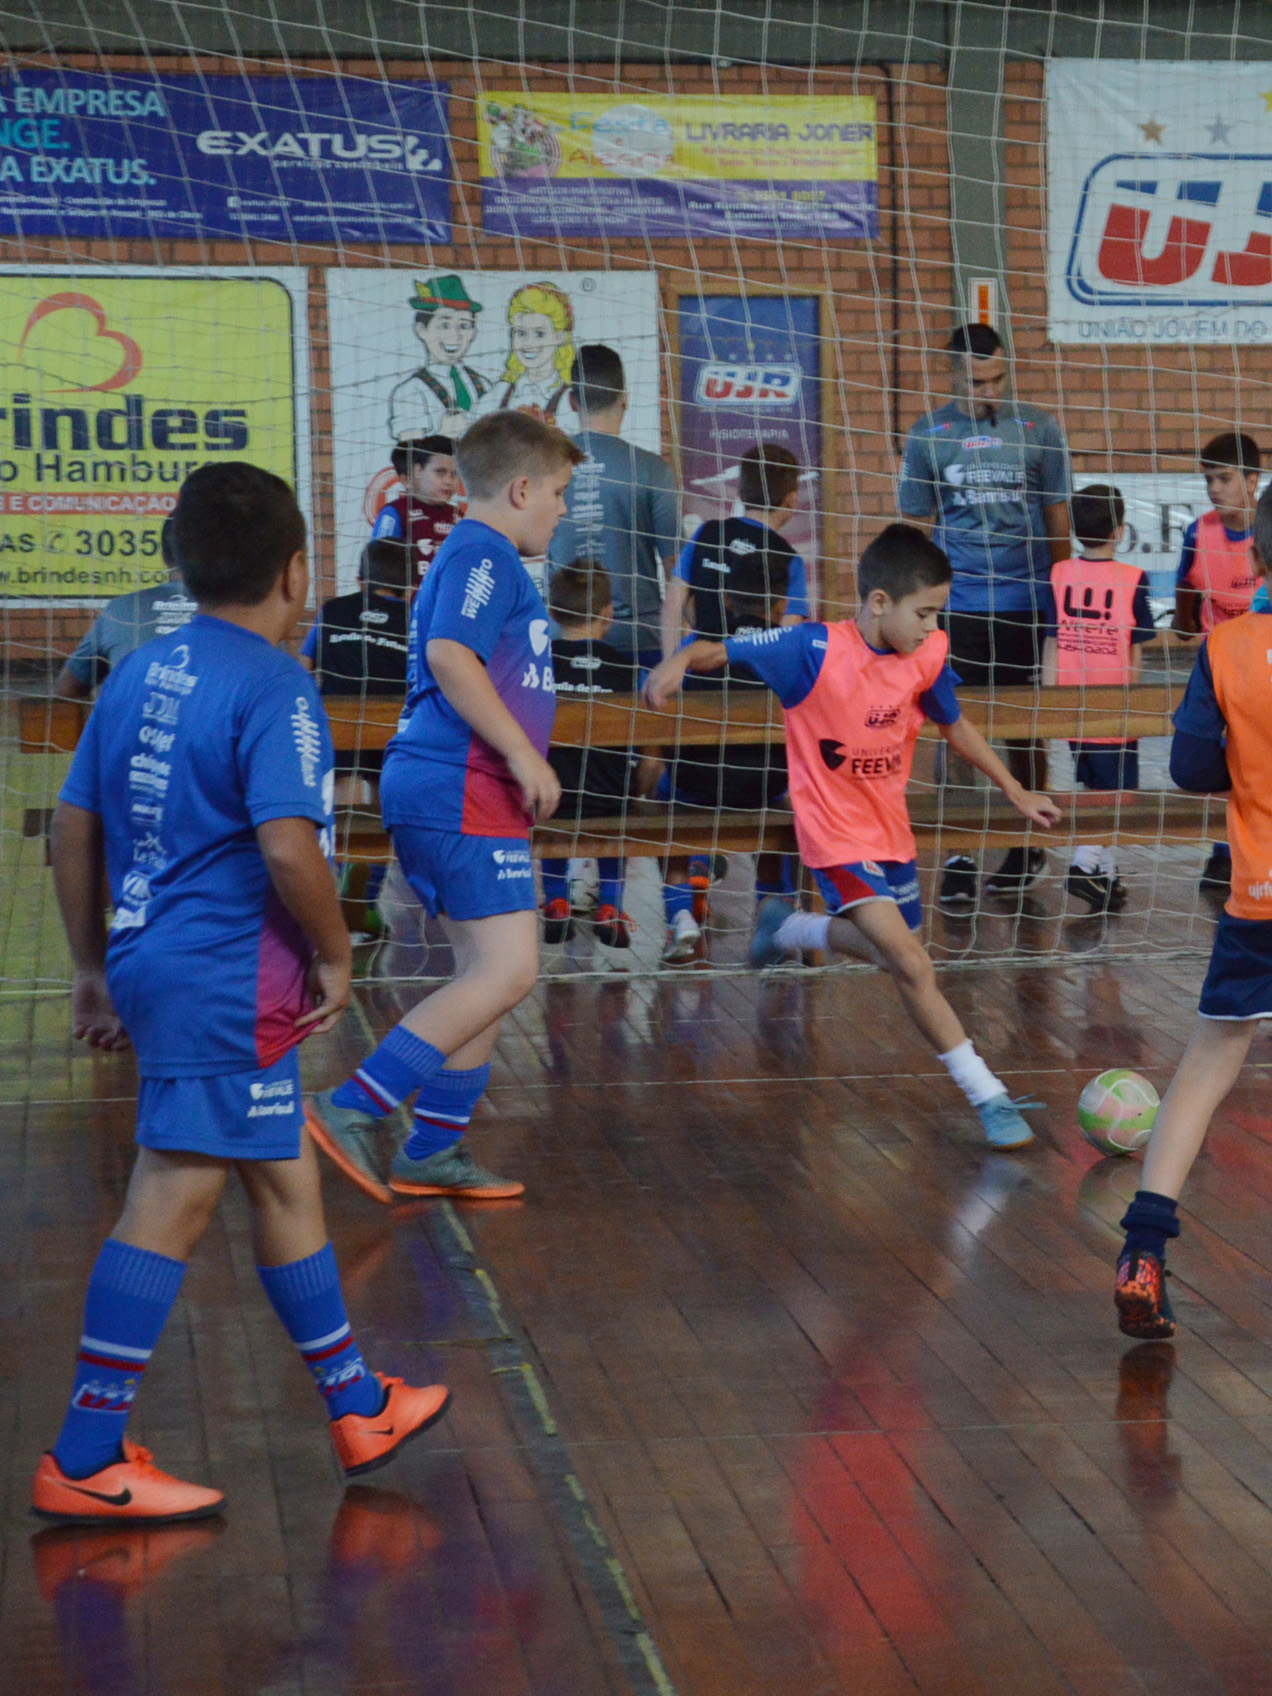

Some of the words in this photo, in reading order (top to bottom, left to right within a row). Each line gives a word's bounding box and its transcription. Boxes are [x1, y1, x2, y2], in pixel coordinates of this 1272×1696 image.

[14, 87, 166, 117] EMPRESA
[197, 130, 404, 159] EXATUS
[685, 122, 790, 142] LIVRARIA
[799, 122, 874, 142] JONER
[30, 156, 157, 186] EXATUS.
[1078, 315, 1148, 339] UNIÃO
[1152, 319, 1229, 339] JOVEM
[1236, 319, 1269, 339] DO
[704, 370, 791, 399] UJR
[27, 495, 177, 514] COMUNICAÇÃO
